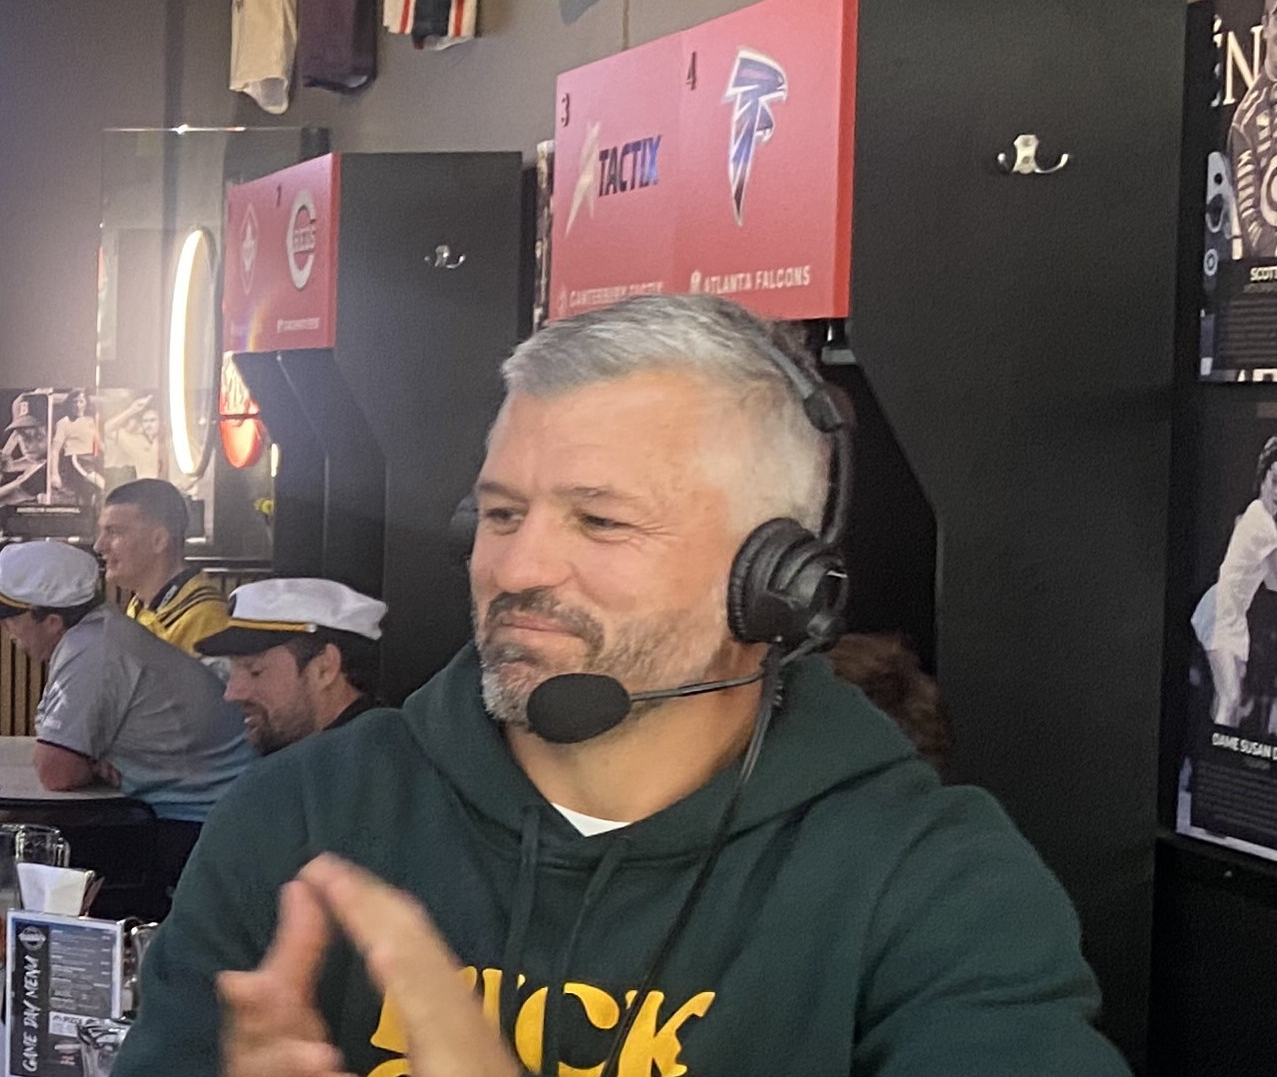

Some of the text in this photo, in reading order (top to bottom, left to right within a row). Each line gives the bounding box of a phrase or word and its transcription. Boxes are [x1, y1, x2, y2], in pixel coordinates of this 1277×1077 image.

[686, 50, 697, 90] 4
[560, 92, 570, 127] 3
[598, 135, 662, 197] TACTIX
[704, 264, 811, 295] ATLANTA FALCONS
[23, 954, 41, 999] MENU
[23, 999, 41, 1030] DAY
[22, 1032, 40, 1072] GAME
